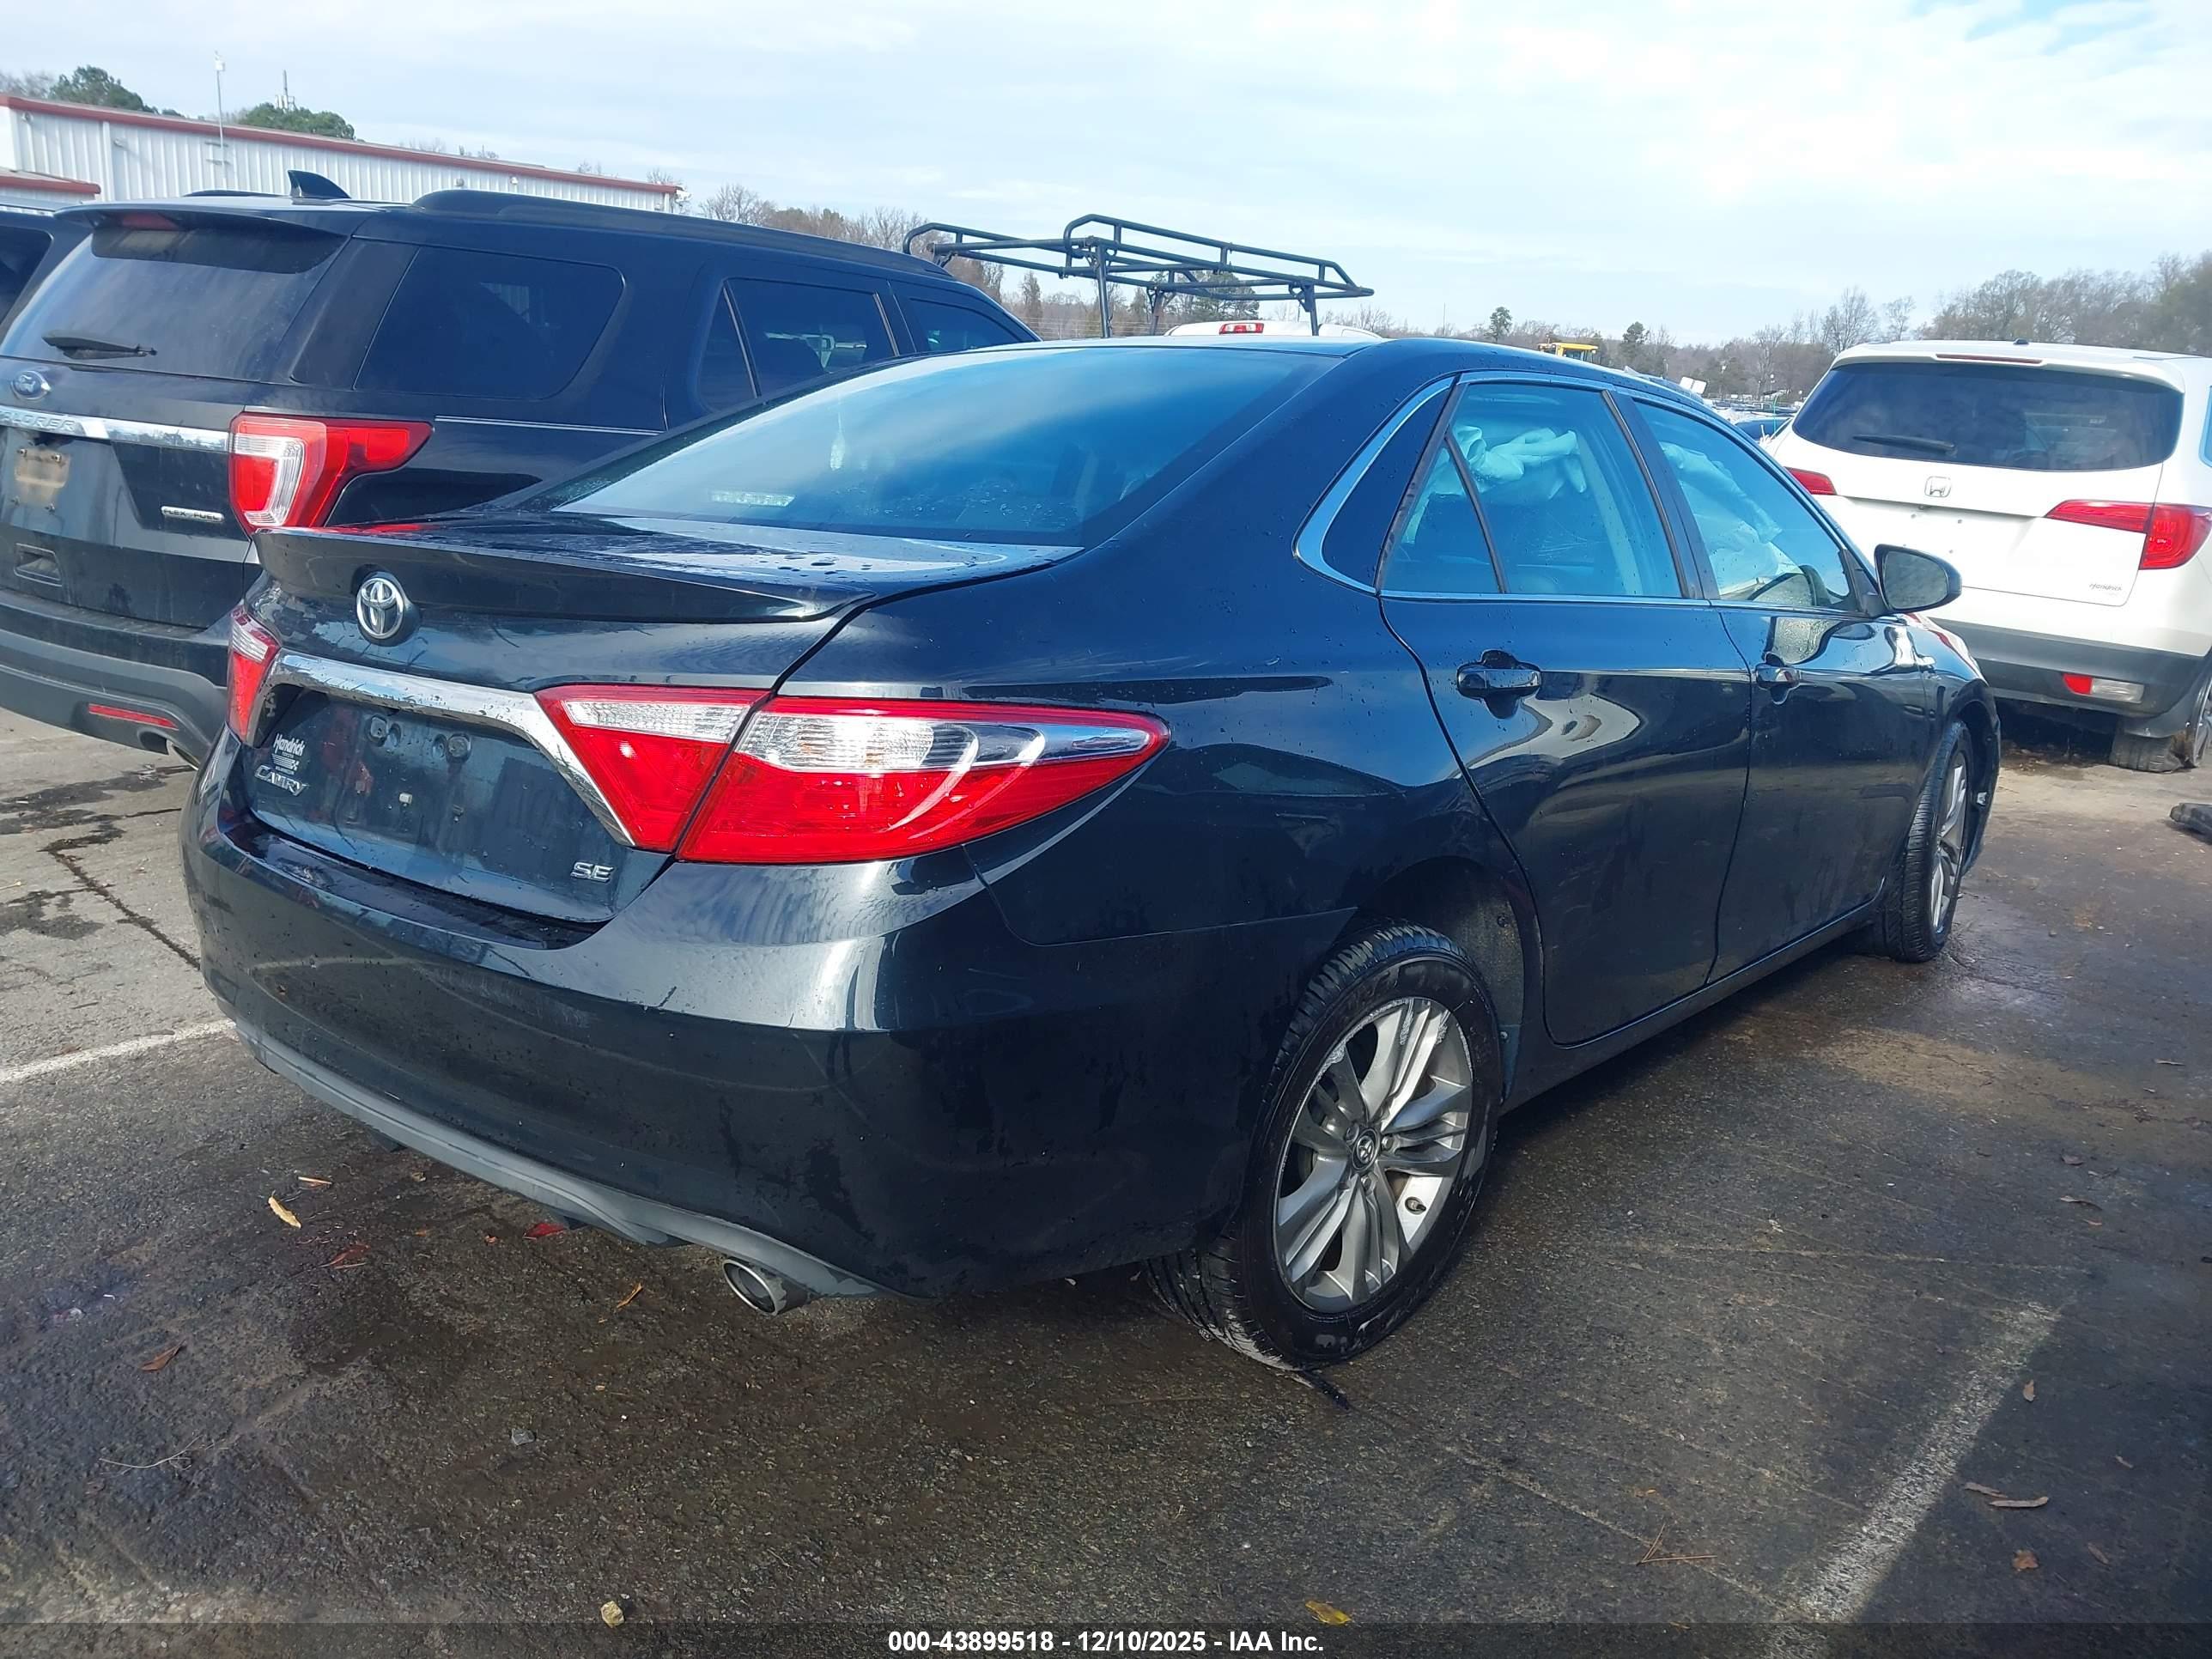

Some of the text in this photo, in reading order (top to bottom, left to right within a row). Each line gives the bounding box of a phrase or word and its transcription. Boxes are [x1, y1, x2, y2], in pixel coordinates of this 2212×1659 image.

[193, 512, 221, 520] FUEL
[273, 732, 306, 756] Hendrick
[254, 764, 310, 797] CAMRY
[570, 861, 614, 883] SE
